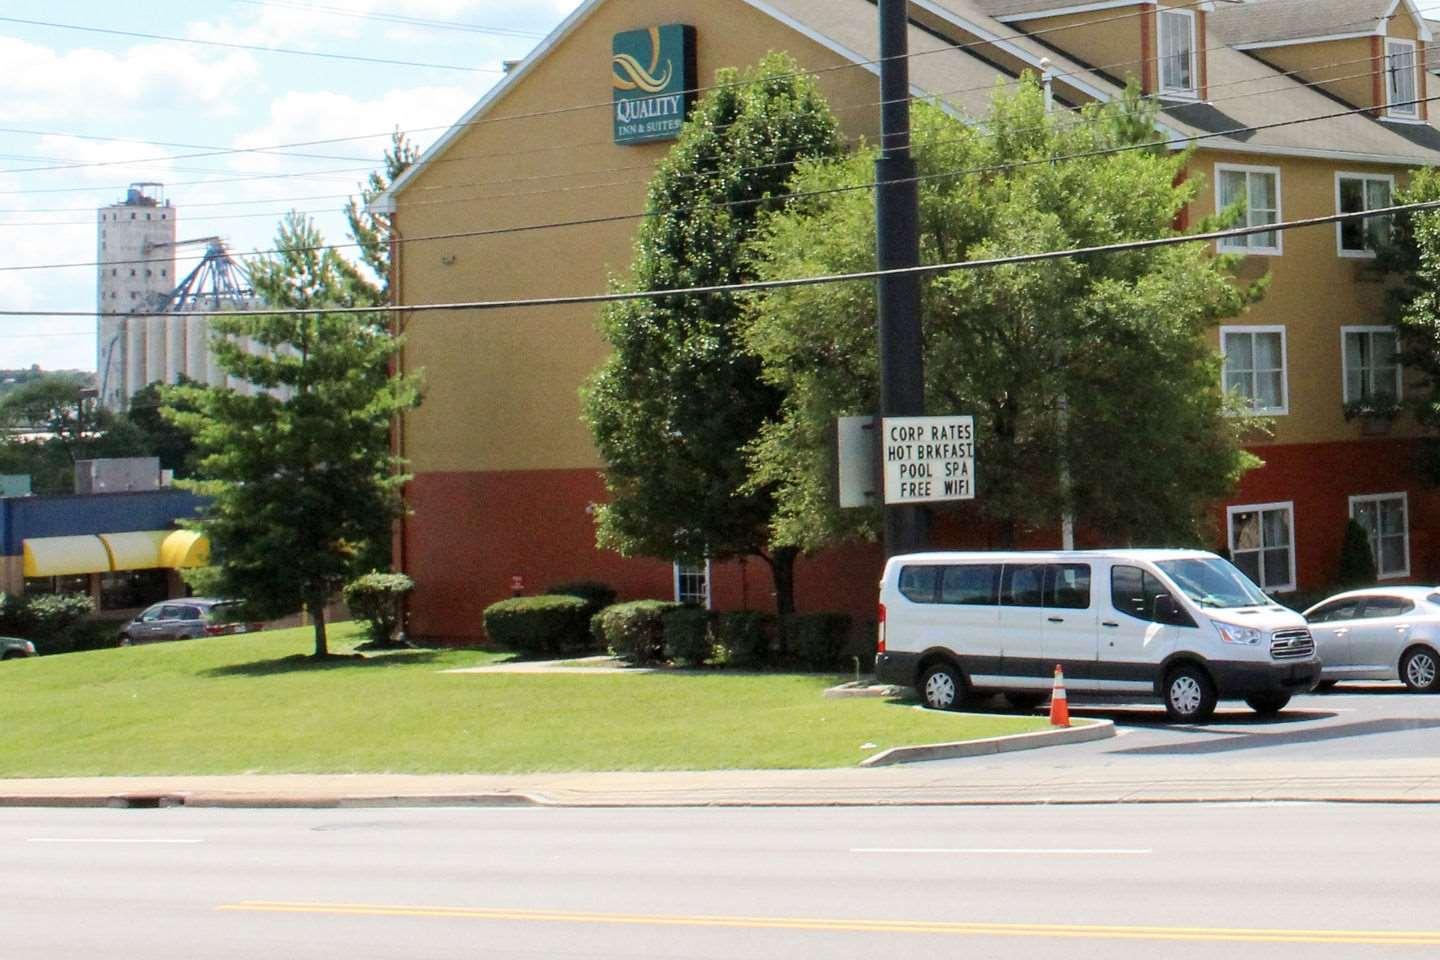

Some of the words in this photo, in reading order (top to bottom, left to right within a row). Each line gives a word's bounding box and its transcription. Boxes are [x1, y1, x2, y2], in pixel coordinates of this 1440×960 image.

[617, 95, 680, 123] QUALITY
[891, 426, 924, 441] CORP
[931, 424, 971, 440] RATES
[888, 445, 913, 461] HOT
[917, 442, 973, 460] BRKFAST
[900, 463, 932, 478] POOL
[945, 461, 968, 476] SPA
[900, 481, 931, 497] FREE
[944, 479, 969, 495] WIFI
